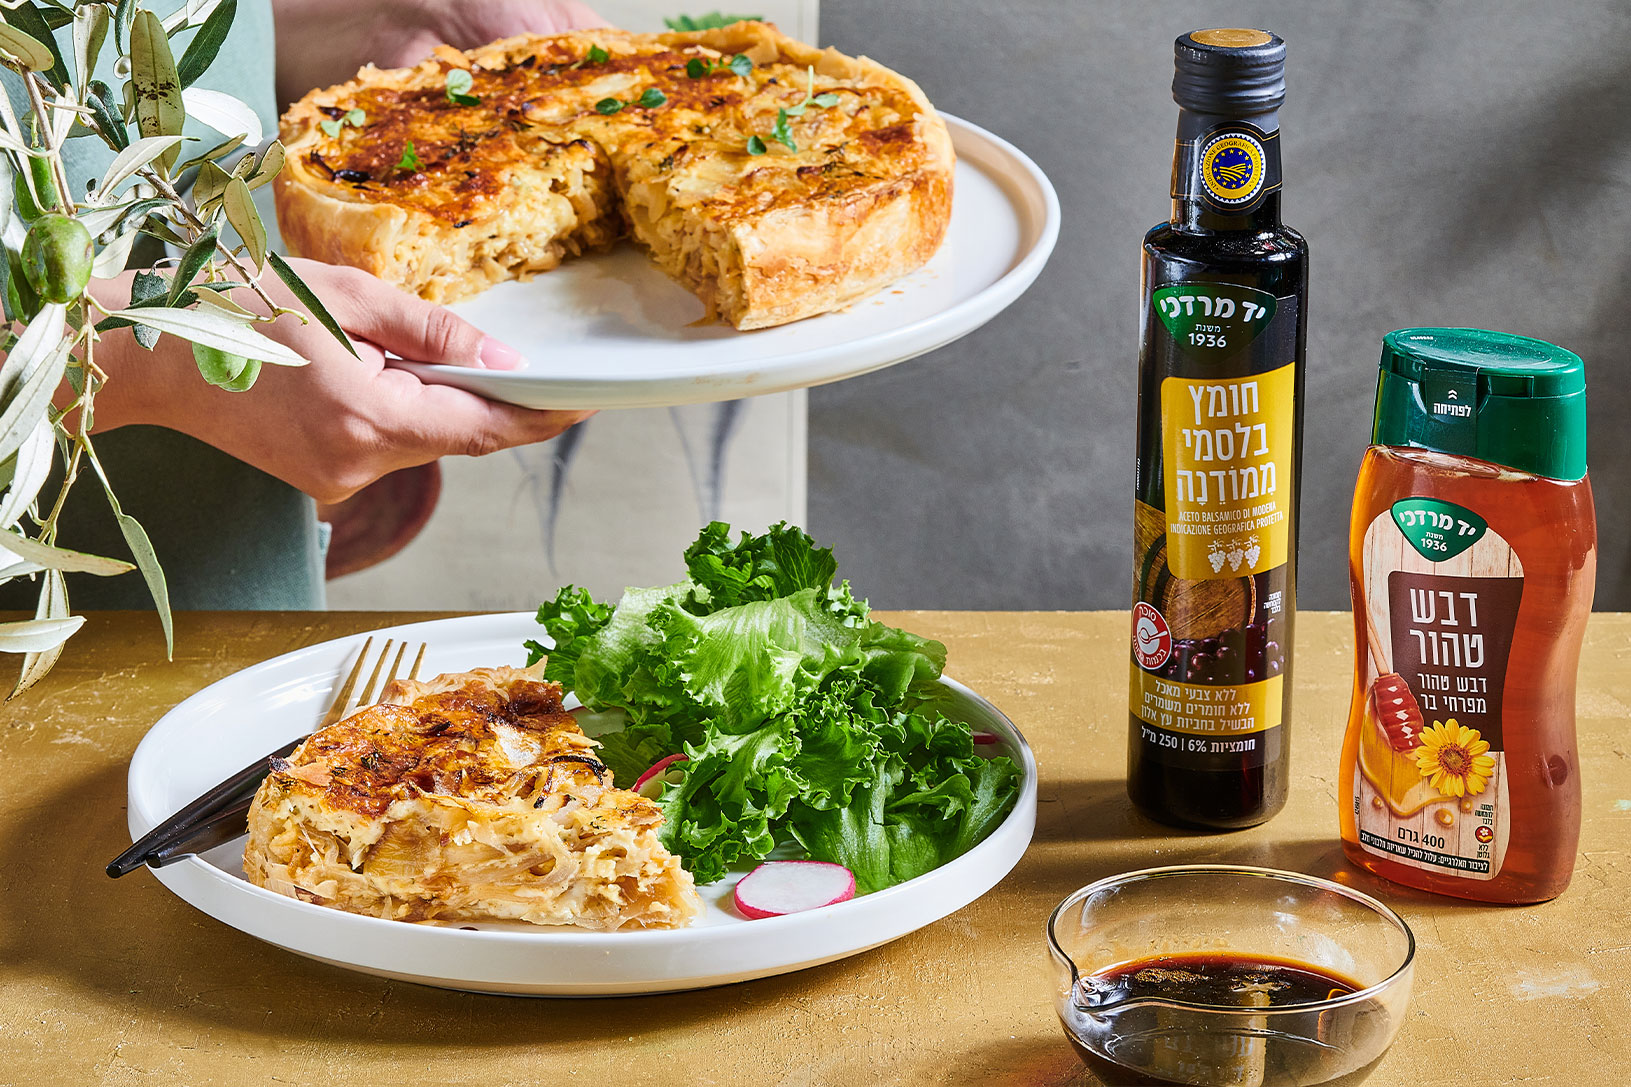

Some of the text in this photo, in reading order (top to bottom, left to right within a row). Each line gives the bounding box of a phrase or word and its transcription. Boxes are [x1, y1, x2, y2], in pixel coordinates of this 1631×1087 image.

[1160, 295, 1266, 323] יד מרדכי
[1195, 323, 1221, 333] משנת
[1188, 333, 1227, 348] 1936
[1188, 381, 1259, 425] חומץ
[1433, 402, 1472, 417] לפתיחה
[1182, 422, 1269, 461] בלסמי
[1178, 501, 1276, 522] ACETO BALSAMICO DI MODENA
[1170, 511, 1284, 535] INDICAZIONE GEOGRAFICA PROTETTA
[1399, 510, 1476, 536] יד מרדכי
[1420, 538, 1448, 552] 1936
[1425, 531, 1444, 540] משנת
[1139, 606, 1157, 622] סוכר
[1409, 588, 1478, 627] דבש
[1409, 629, 1485, 668] טהור
[1155, 680, 1237, 701] ללא צבעי מאכל
[1417, 673, 1487, 693] דבש טהור
[1144, 692, 1251, 716] ללא חומרים משמרים
[1420, 693, 1487, 714] מפרחי בר
[1141, 704, 1255, 731] הבשיל בחביות עץ אלון
[1158, 733, 1178, 749] 250
[1187, 739, 1207, 752] 6%
[1210, 739, 1256, 753] חומציות
[1398, 827, 1445, 849] 400 גרם
